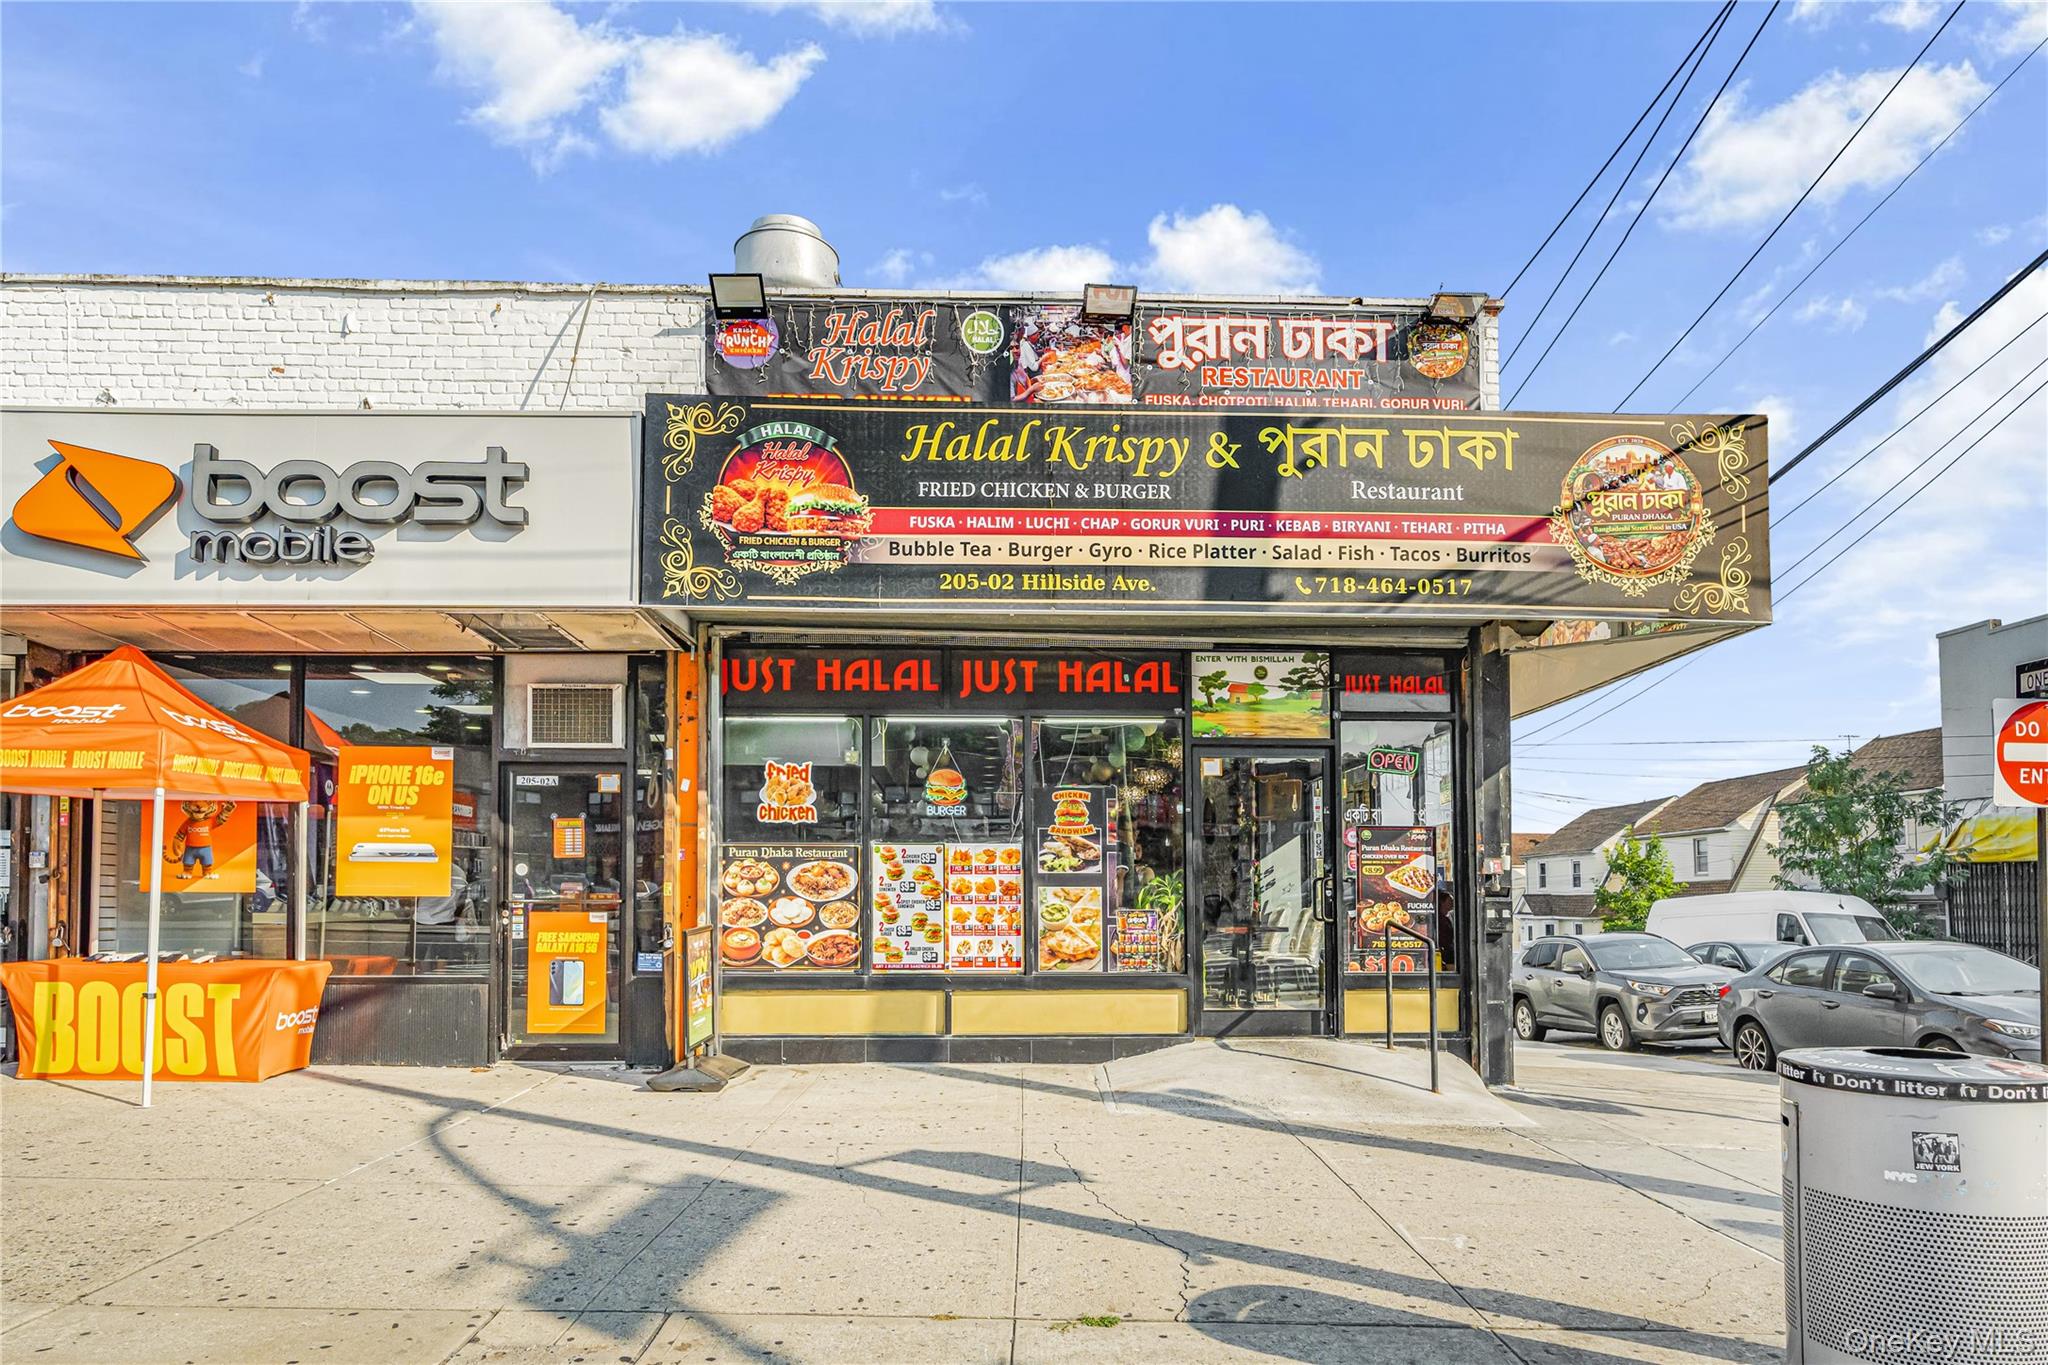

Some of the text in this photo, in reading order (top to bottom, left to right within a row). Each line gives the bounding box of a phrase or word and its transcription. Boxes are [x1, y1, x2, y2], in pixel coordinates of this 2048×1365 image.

[821, 309, 935, 347] Halal
[1148, 315, 1394, 371] পুরান ঢাকা
[808, 347, 931, 392] Krispy
[1202, 365, 1365, 391] RESTAURANT
[1380, 399, 1430, 410] GORUR
[761, 423, 813, 439] HALAL
[762, 441, 812, 461] Halal
[901, 419, 1242, 478] Halal Krispy &
[1258, 423, 1520, 480] পুরান ঢাকা
[752, 460, 816, 488] Krispy
[192, 443, 531, 526] boost
[918, 481, 1172, 500] FRIED CHICKEN & BURGER
[1351, 480, 1464, 501] Restaurant
[1641, 489, 1686, 511] ঢাকা
[909, 516, 1506, 535] FUSKA HALIM LUCHI CHAP GORUR VURI PURI KEBAB BIRYANI TEHARI PITHA
[1612, 513, 1673, 521] PURAN DHAKA
[1672, 523, 1687, 531] USA
[190, 525, 375, 566] mobile
[739, 536, 841, 547] FRIED CHICKEN & BURGER
[889, 541, 1531, 564] Bubble Tea Burger Gyro Rice Platter Salad Fish Tacos Burritos
[940, 573, 1157, 592] 205-02 Hillside Ave.
[1315, 576, 1473, 596] 718-464-0517
[1226, 655, 1248, 663] WITH
[1251, 655, 1295, 663] BISMILLAH
[816, 658, 940, 692] HALAL
[960, 658, 1179, 698] JUST HALAL
[2027, 672, 2048, 689] ONE
[1344, 674, 1446, 697] JUST HALAL
[3, 704, 128, 718] boost
[2015, 720, 2040, 737] DO
[31, 749, 67, 768] MOBILE
[72, 750, 108, 768] BOOST
[107, 751, 145, 769] MOBILE
[1371, 751, 1415, 771] OPEN
[349, 765, 445, 786] iPHONE 16e
[367, 785, 420, 805] ON US
[1053, 791, 1090, 801] CHICKEN
[926, 805, 966, 816] BURGER
[1049, 826, 1095, 835] SANDWICH
[728, 846, 848, 859] Puran Dhaka Restaurant
[1315, 833, 1323, 857] PUSH
[1381, 844, 1400, 852] Dhaka
[1371, 940, 1422, 948] 71864-0517
[275, 1005, 319, 1031] boost
[32, 980, 241, 1077] BOOST
[1782, 1063, 1806, 1080] litter
[1833, 1073, 1948, 1097] Don't litter
[1988, 1085, 2038, 1100] Don't
[1883, 1169, 1918, 1184] NYC
[1935, 1164, 1960, 1172] YORK
